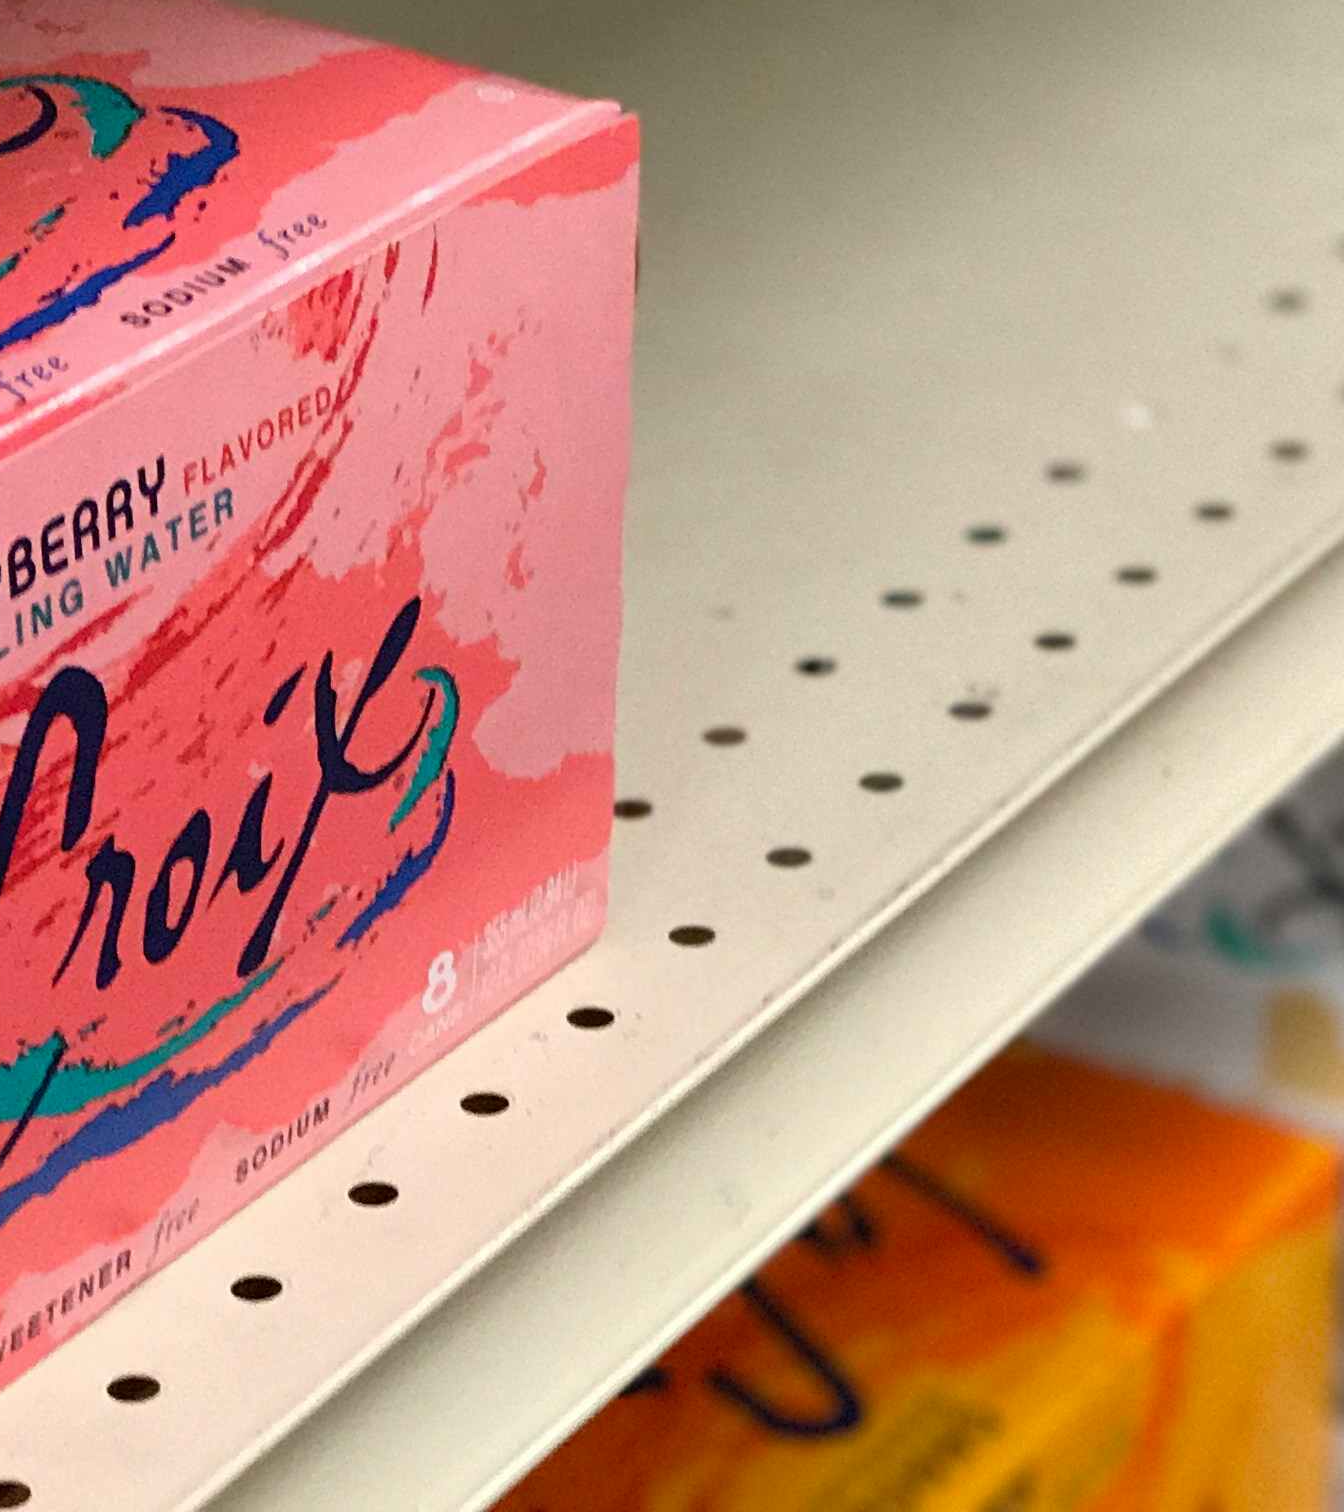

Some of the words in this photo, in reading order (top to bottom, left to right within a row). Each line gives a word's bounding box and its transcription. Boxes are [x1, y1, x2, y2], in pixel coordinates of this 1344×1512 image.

[118, 254, 253, 330] SODIUM
[254, 209, 330, 263] free
[181, 386, 333, 495] FLAVORED
[104, 486, 238, 590] WATER
[421, 950, 457, 1015] 8
[233, 1097, 333, 1187] SODIUM
